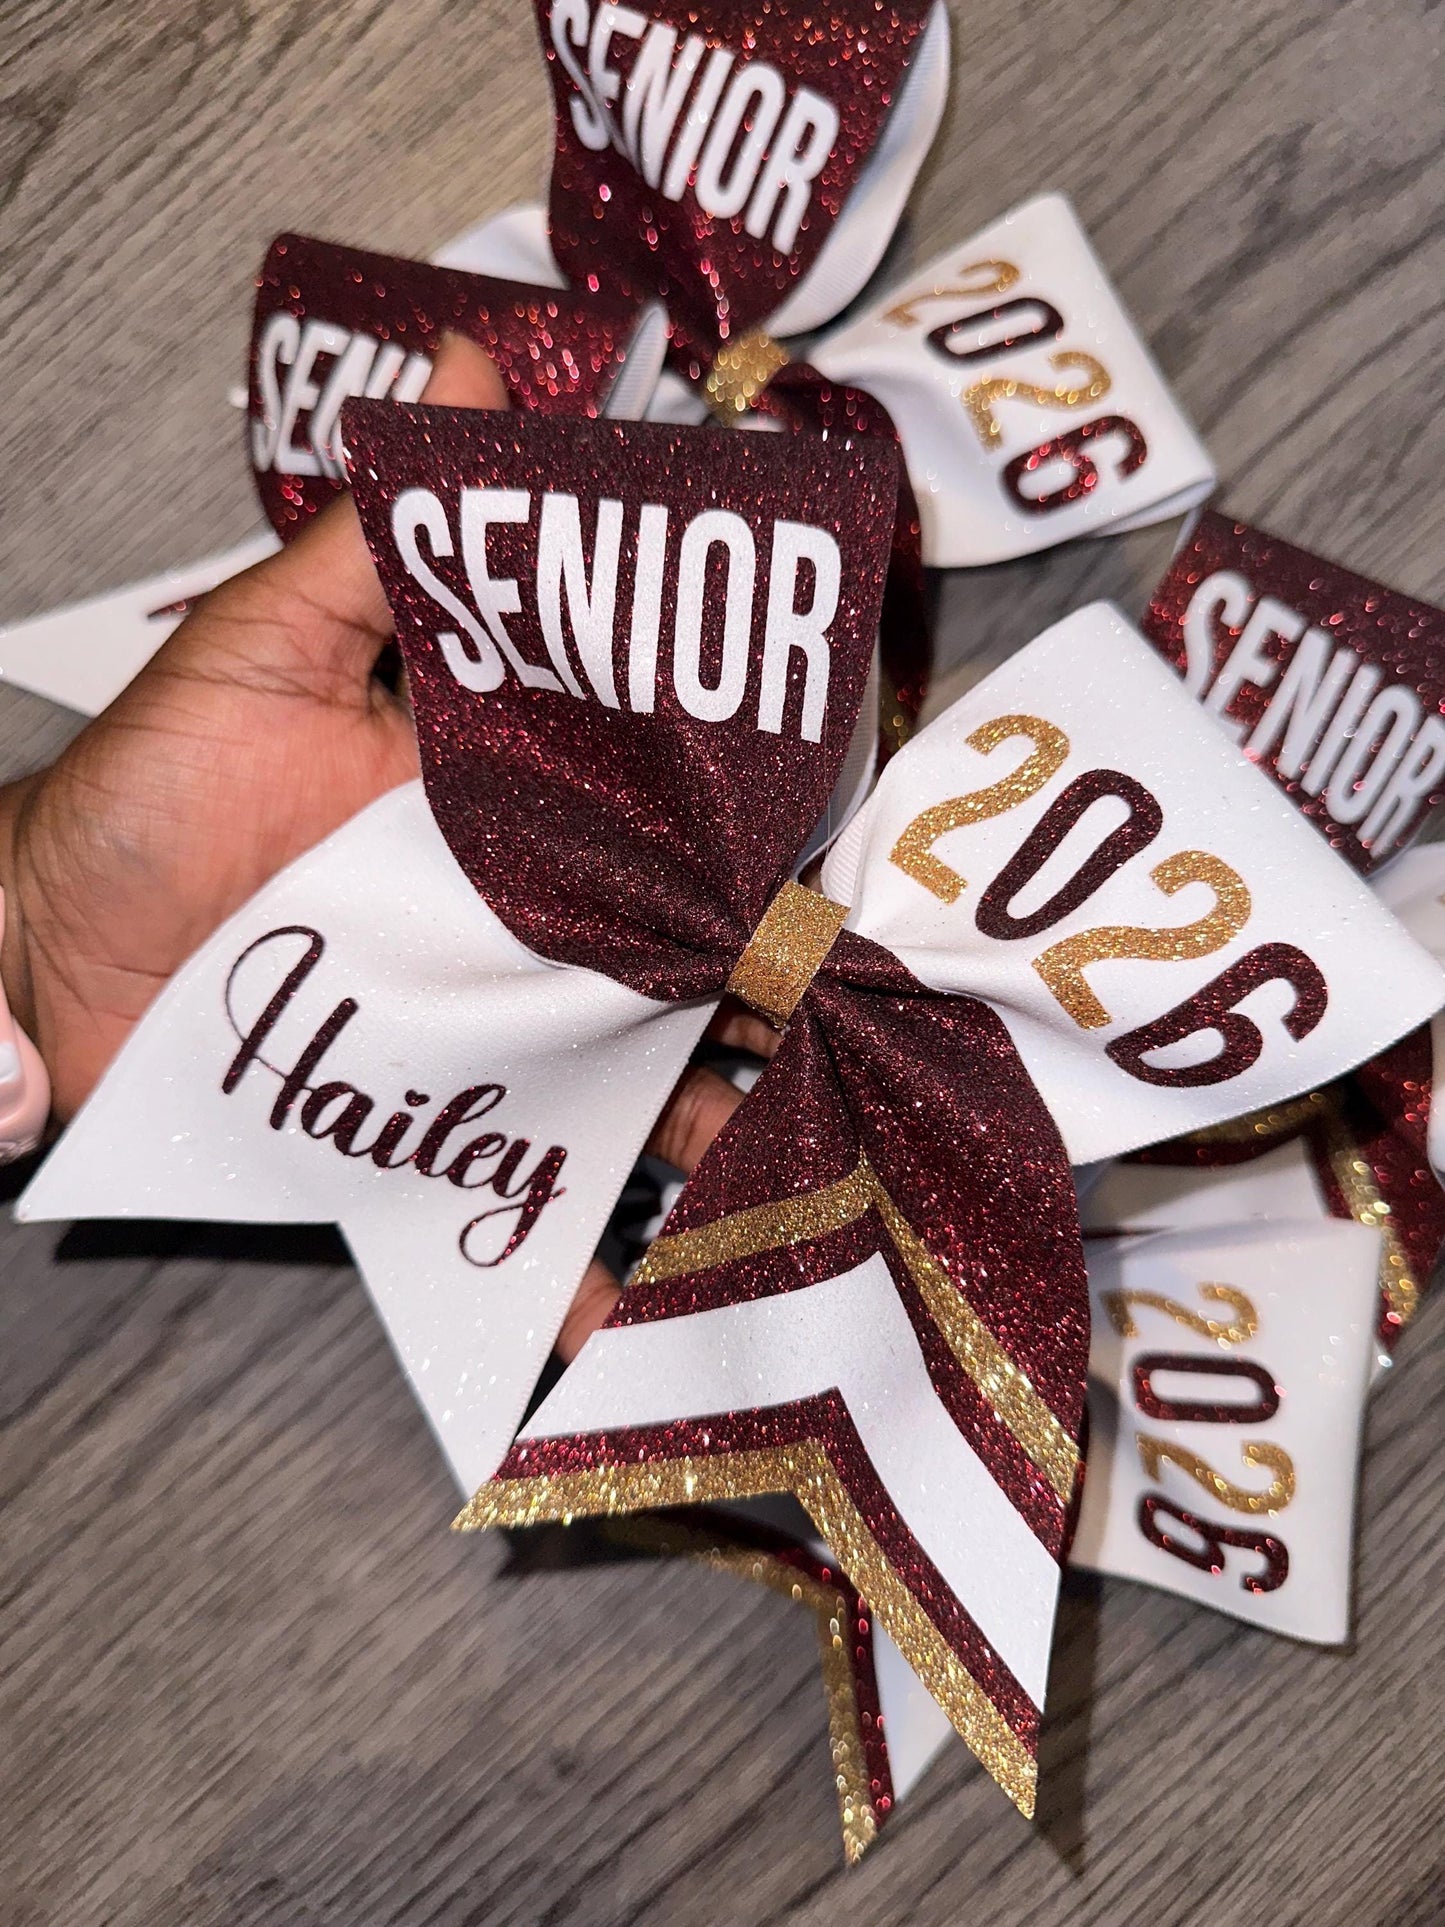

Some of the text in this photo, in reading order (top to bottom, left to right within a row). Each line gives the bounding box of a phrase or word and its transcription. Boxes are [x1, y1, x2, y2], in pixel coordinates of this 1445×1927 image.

[550, 0, 840, 257] SENIOR
[252, 312, 434, 480] SEN
[879, 259, 1148, 519] 2026
[391, 487, 842, 744] SENIOR
[1182, 569, 1445, 858] SENIOR
[888, 714, 1328, 1088] 2026
[221, 925, 567, 1267] Hailey
[1105, 1281, 1298, 1594] 2026
